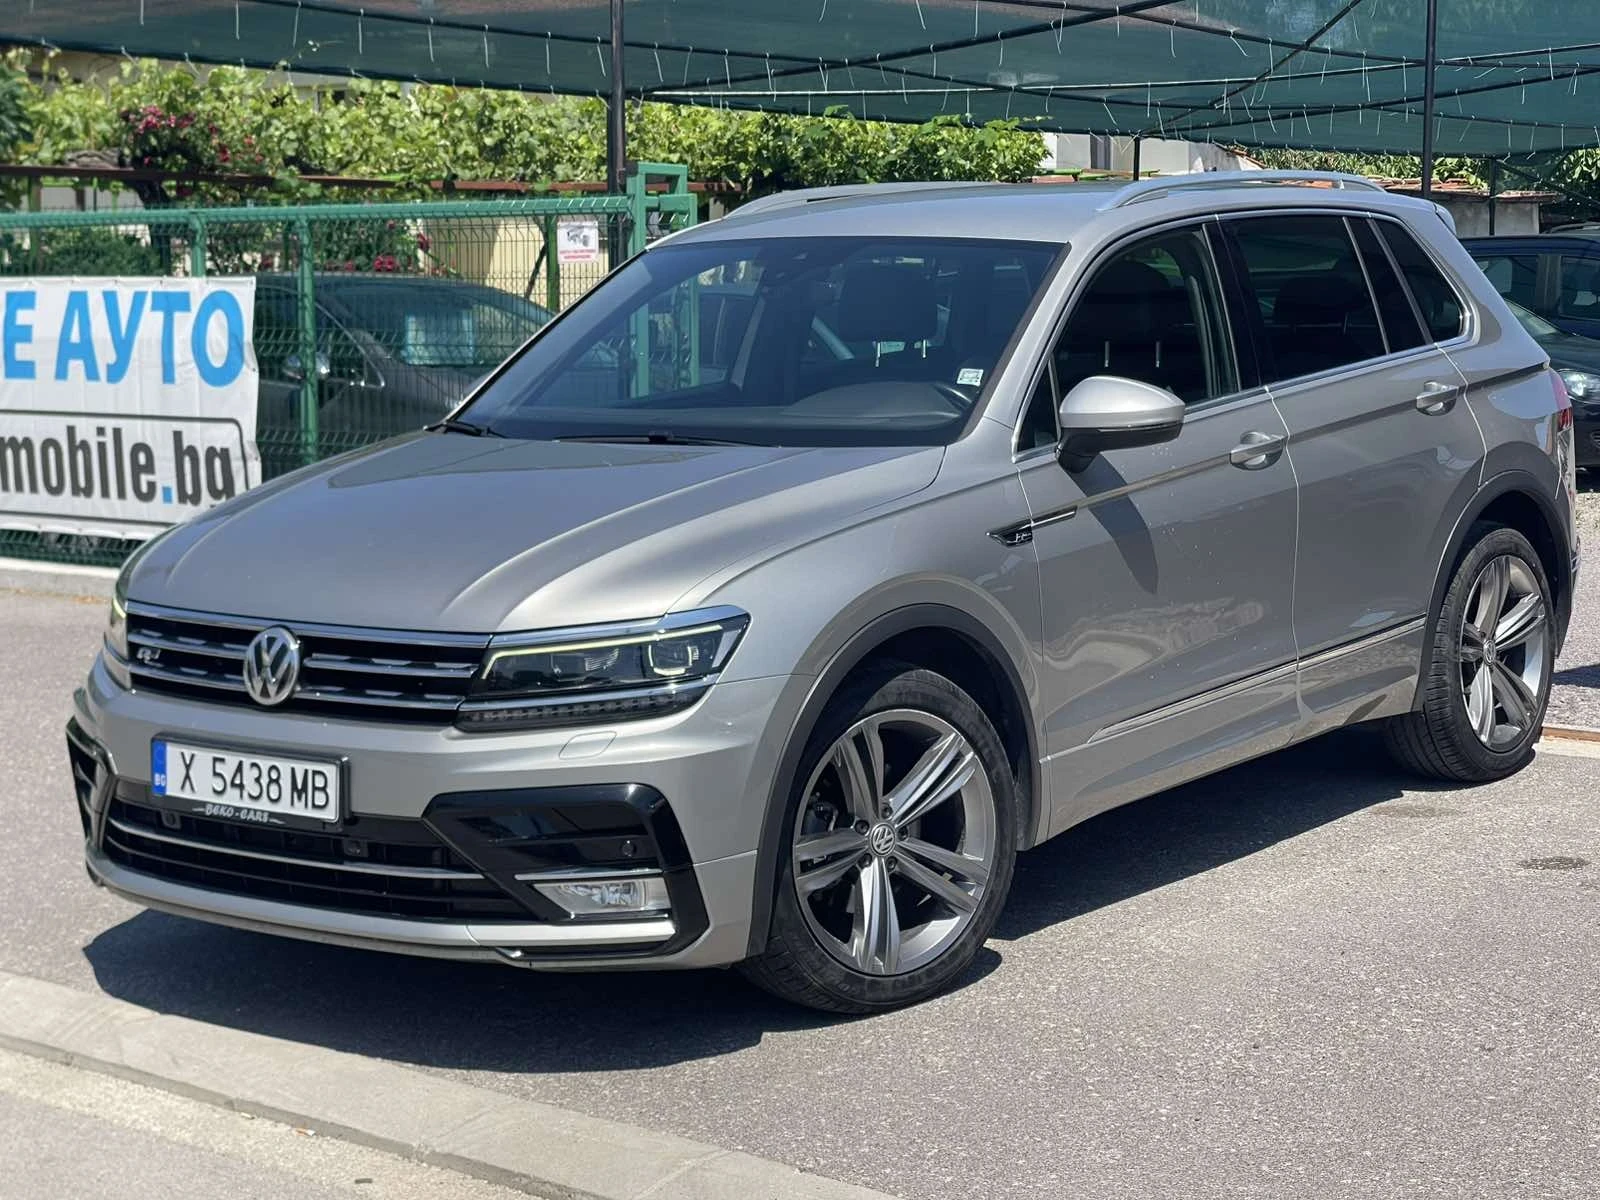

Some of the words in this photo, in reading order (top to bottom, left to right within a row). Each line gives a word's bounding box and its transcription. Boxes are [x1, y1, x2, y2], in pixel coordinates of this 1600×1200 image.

[54, 290, 245, 388] АУТО
[0, 425, 236, 508] mobile.bg
[154, 773, 166, 786] BG
[211, 756, 282, 804] 5438
[291, 766, 330, 810] MB
